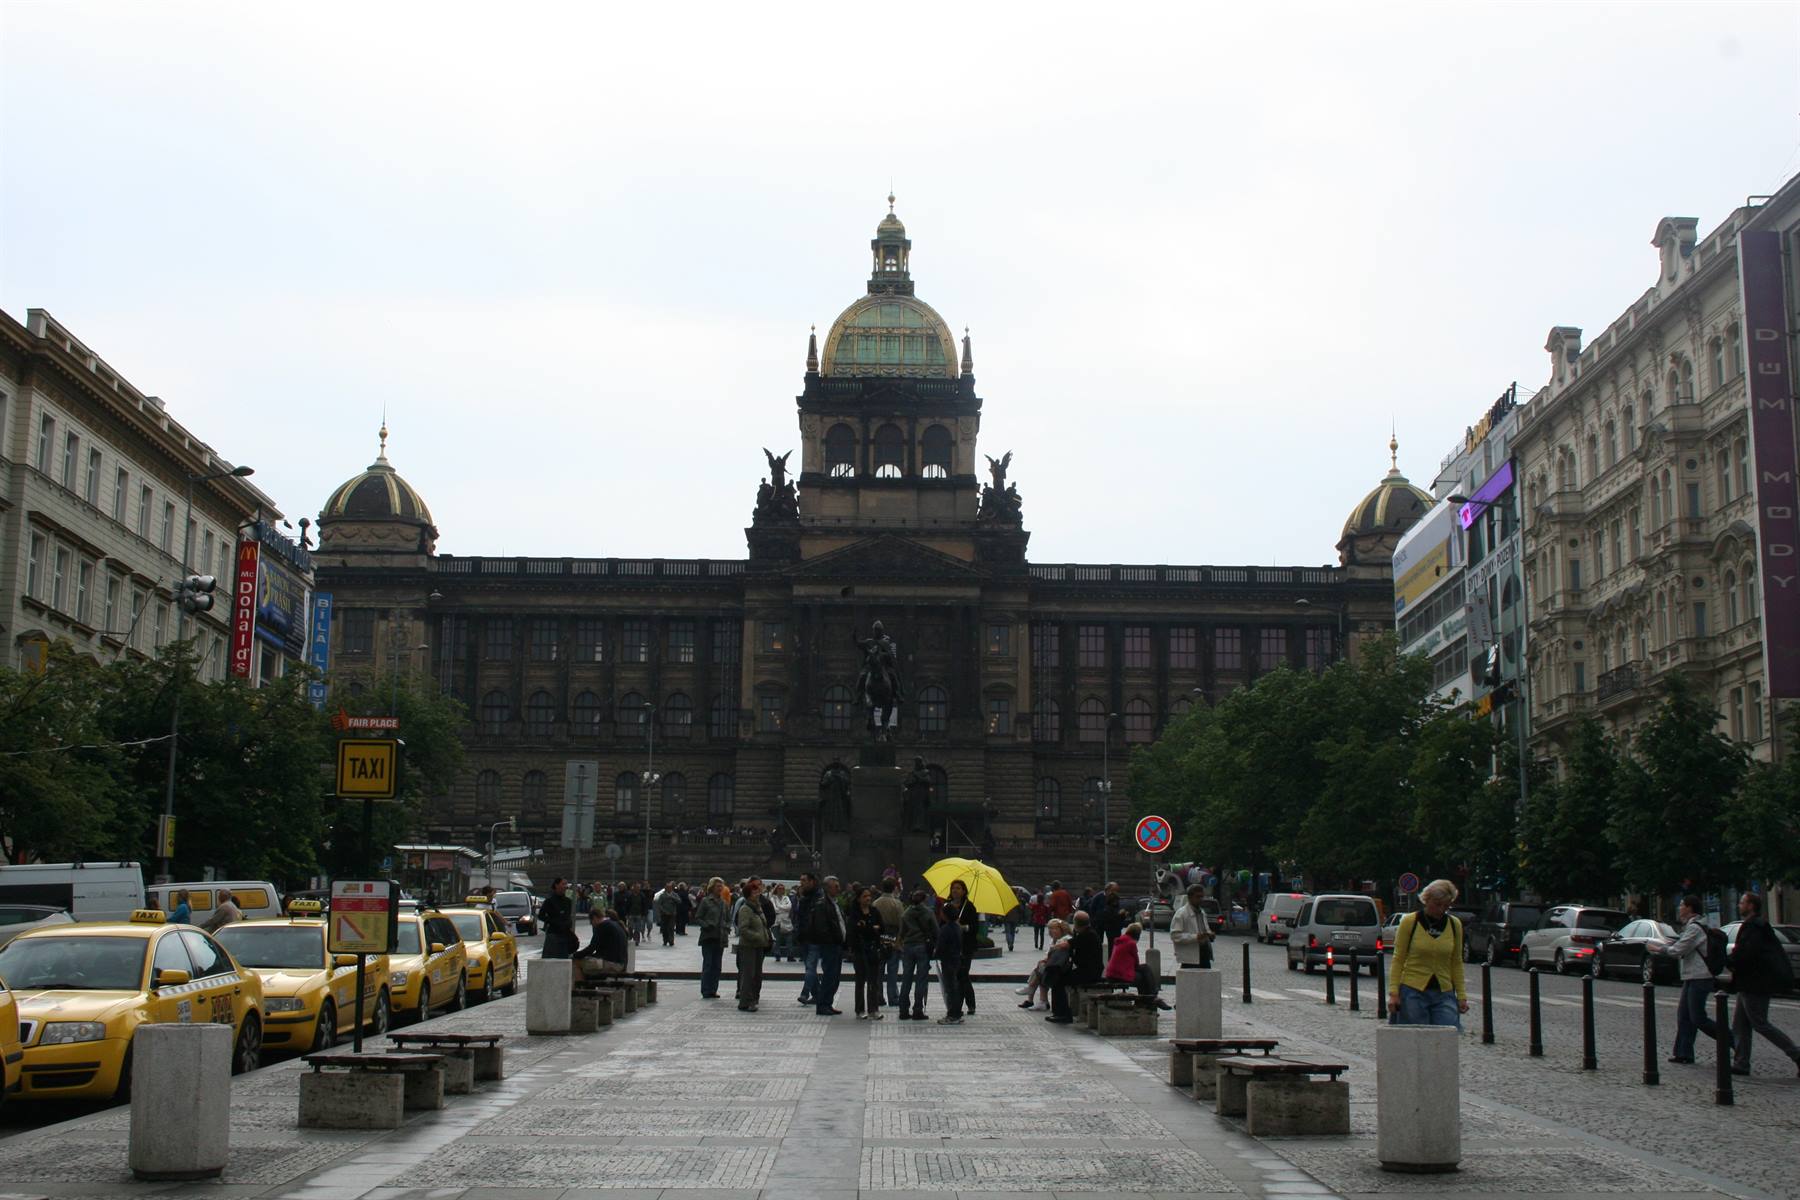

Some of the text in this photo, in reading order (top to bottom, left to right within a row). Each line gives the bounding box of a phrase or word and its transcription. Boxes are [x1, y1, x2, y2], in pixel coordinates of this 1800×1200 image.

[348, 718, 398, 728] FAIR PLACE
[348, 757, 385, 779] TAXI
[134, 911, 159, 919] TAXI
